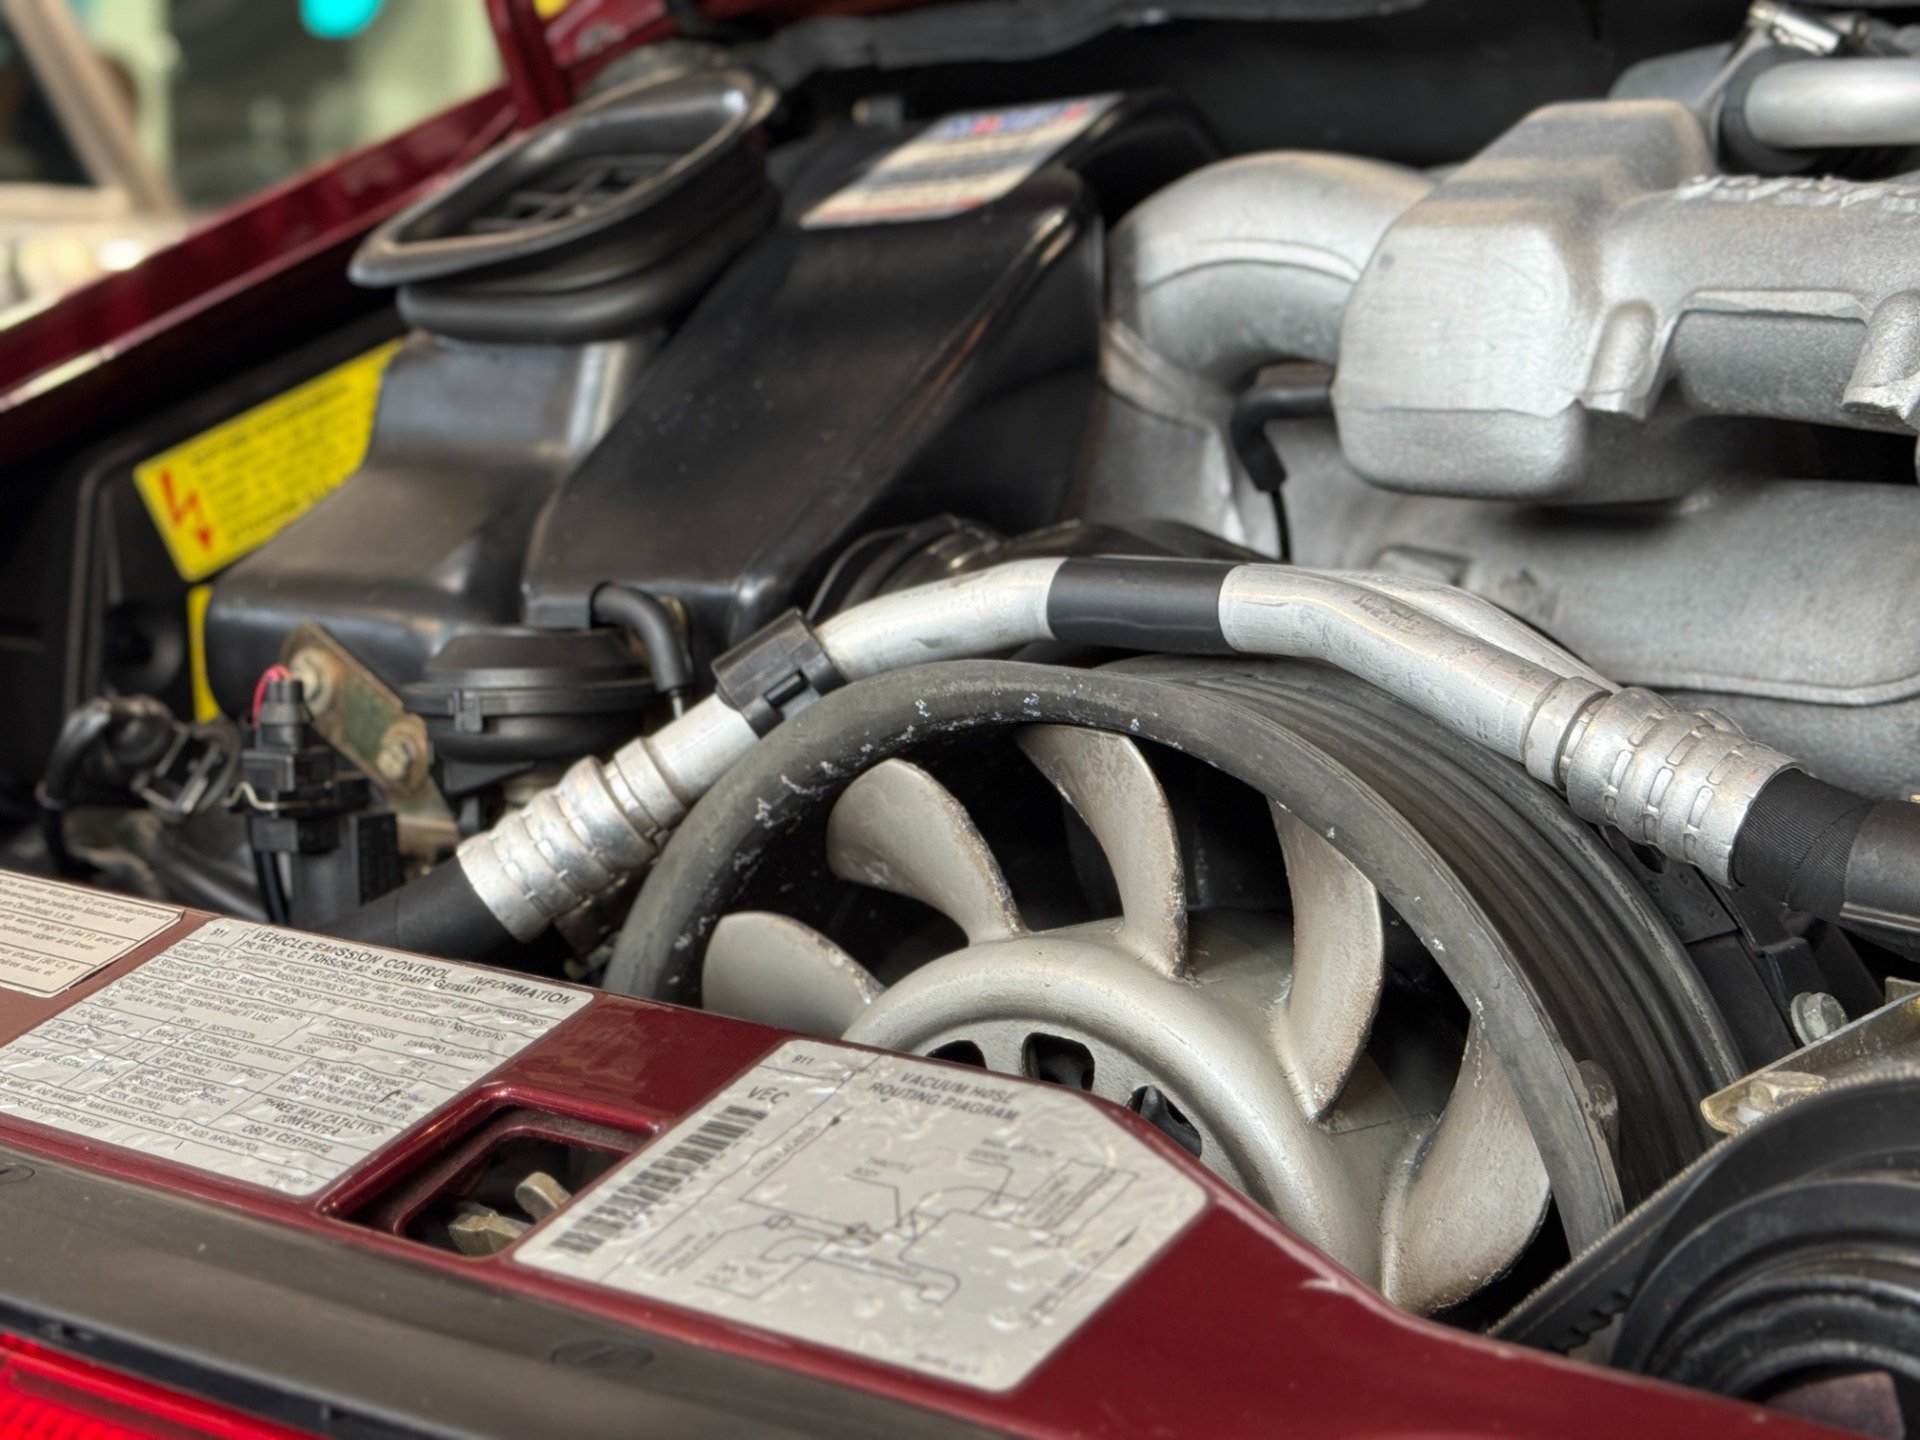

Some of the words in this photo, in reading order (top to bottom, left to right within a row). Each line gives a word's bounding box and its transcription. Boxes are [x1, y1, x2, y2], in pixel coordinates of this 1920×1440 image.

[36, 923, 64, 932] engine
[73, 941, 95, 950] lower
[253, 931, 312, 949] VEHICLE
[383, 958, 451, 979] CONTROL
[469, 976, 574, 1004] INFORMATION
[308, 953, 355, 969] PORSCHE
[371, 968, 430, 984] STUTTGART
[251, 1012, 279, 1024] LEAST
[791, 1054, 814, 1064] 911
[748, 1086, 789, 1104] VEC
[867, 1082, 940, 1105] ROUTING
[942, 1097, 1019, 1122] DIAGRAM
[901, 1072, 968, 1093] VACUUM
[970, 1087, 1016, 1104] HOSE
[262, 1098, 297, 1112] THREE
[297, 1108, 323, 1118] WAY
[322, 1114, 384, 1134] CATALYTIC
[241, 1124, 268, 1135] OBD
[276, 1133, 333, 1153] CERTIFIED
